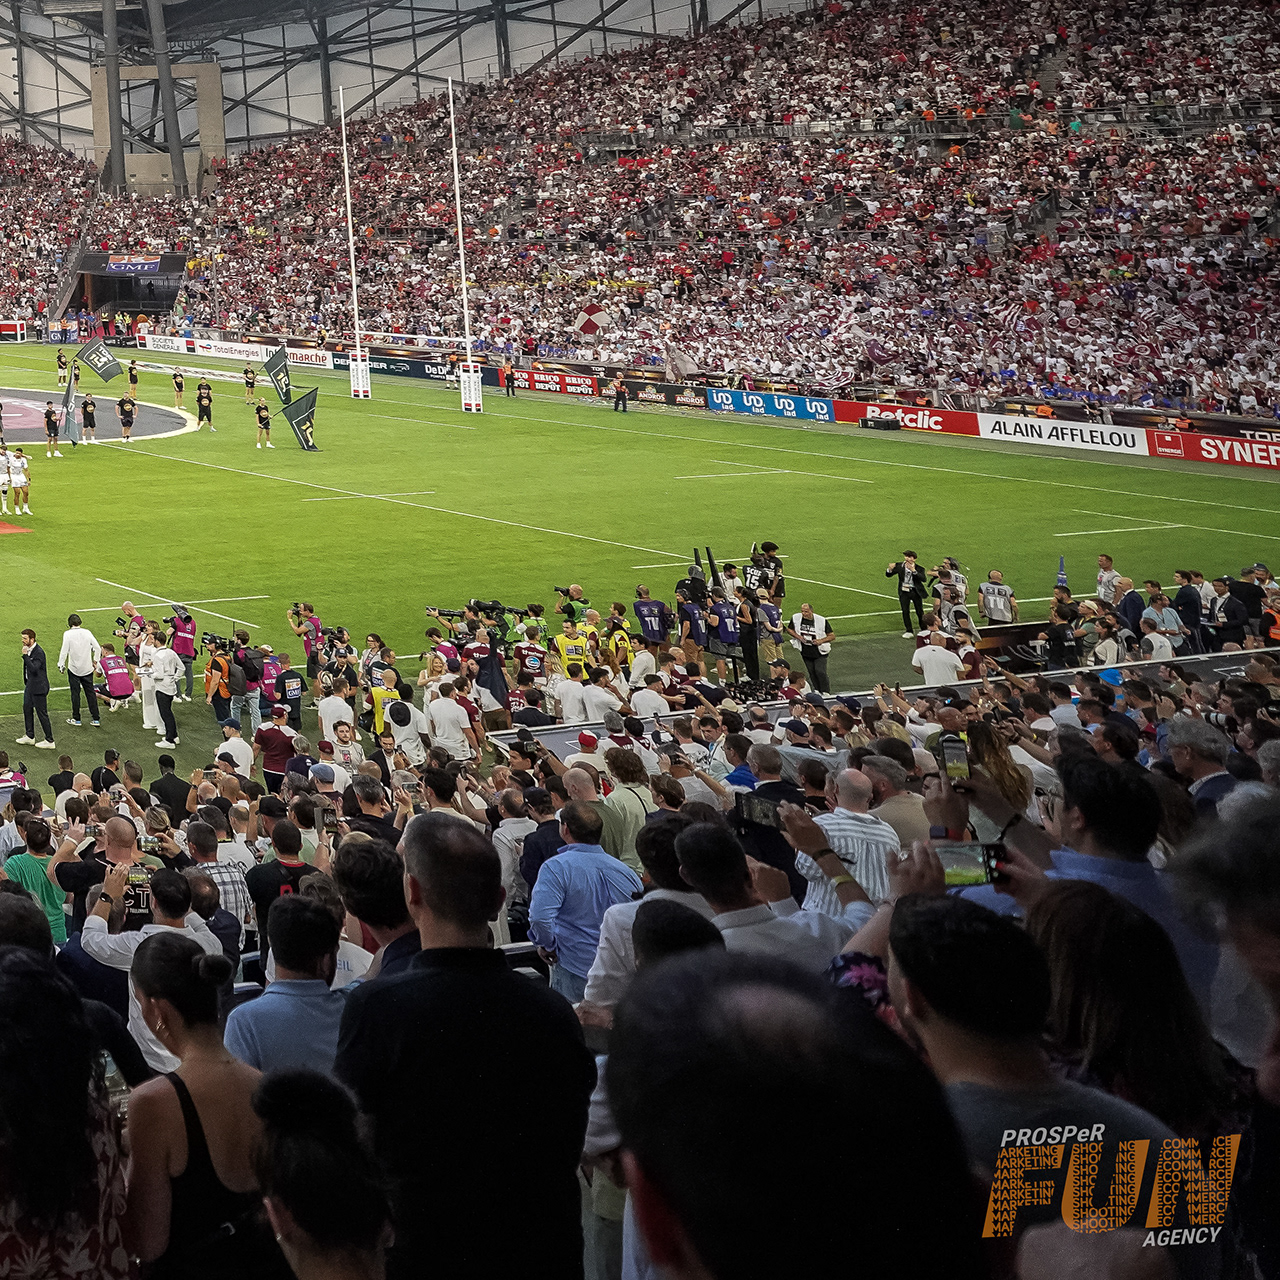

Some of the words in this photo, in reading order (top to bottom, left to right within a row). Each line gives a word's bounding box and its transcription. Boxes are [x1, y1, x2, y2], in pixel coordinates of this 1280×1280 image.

[213, 345, 259, 358] TotalEnergies
[534, 372, 560, 383] BRICO
[565, 376, 592, 386] BRICO
[638, 392, 666, 400] ANDROS
[676, 396, 704, 404] ANDROS
[990, 420, 1042, 440] ALAIN
[1047, 426, 1137, 448] AFFLELOU
[746, 574, 760, 590] 15
[644, 616, 660, 631] TV
